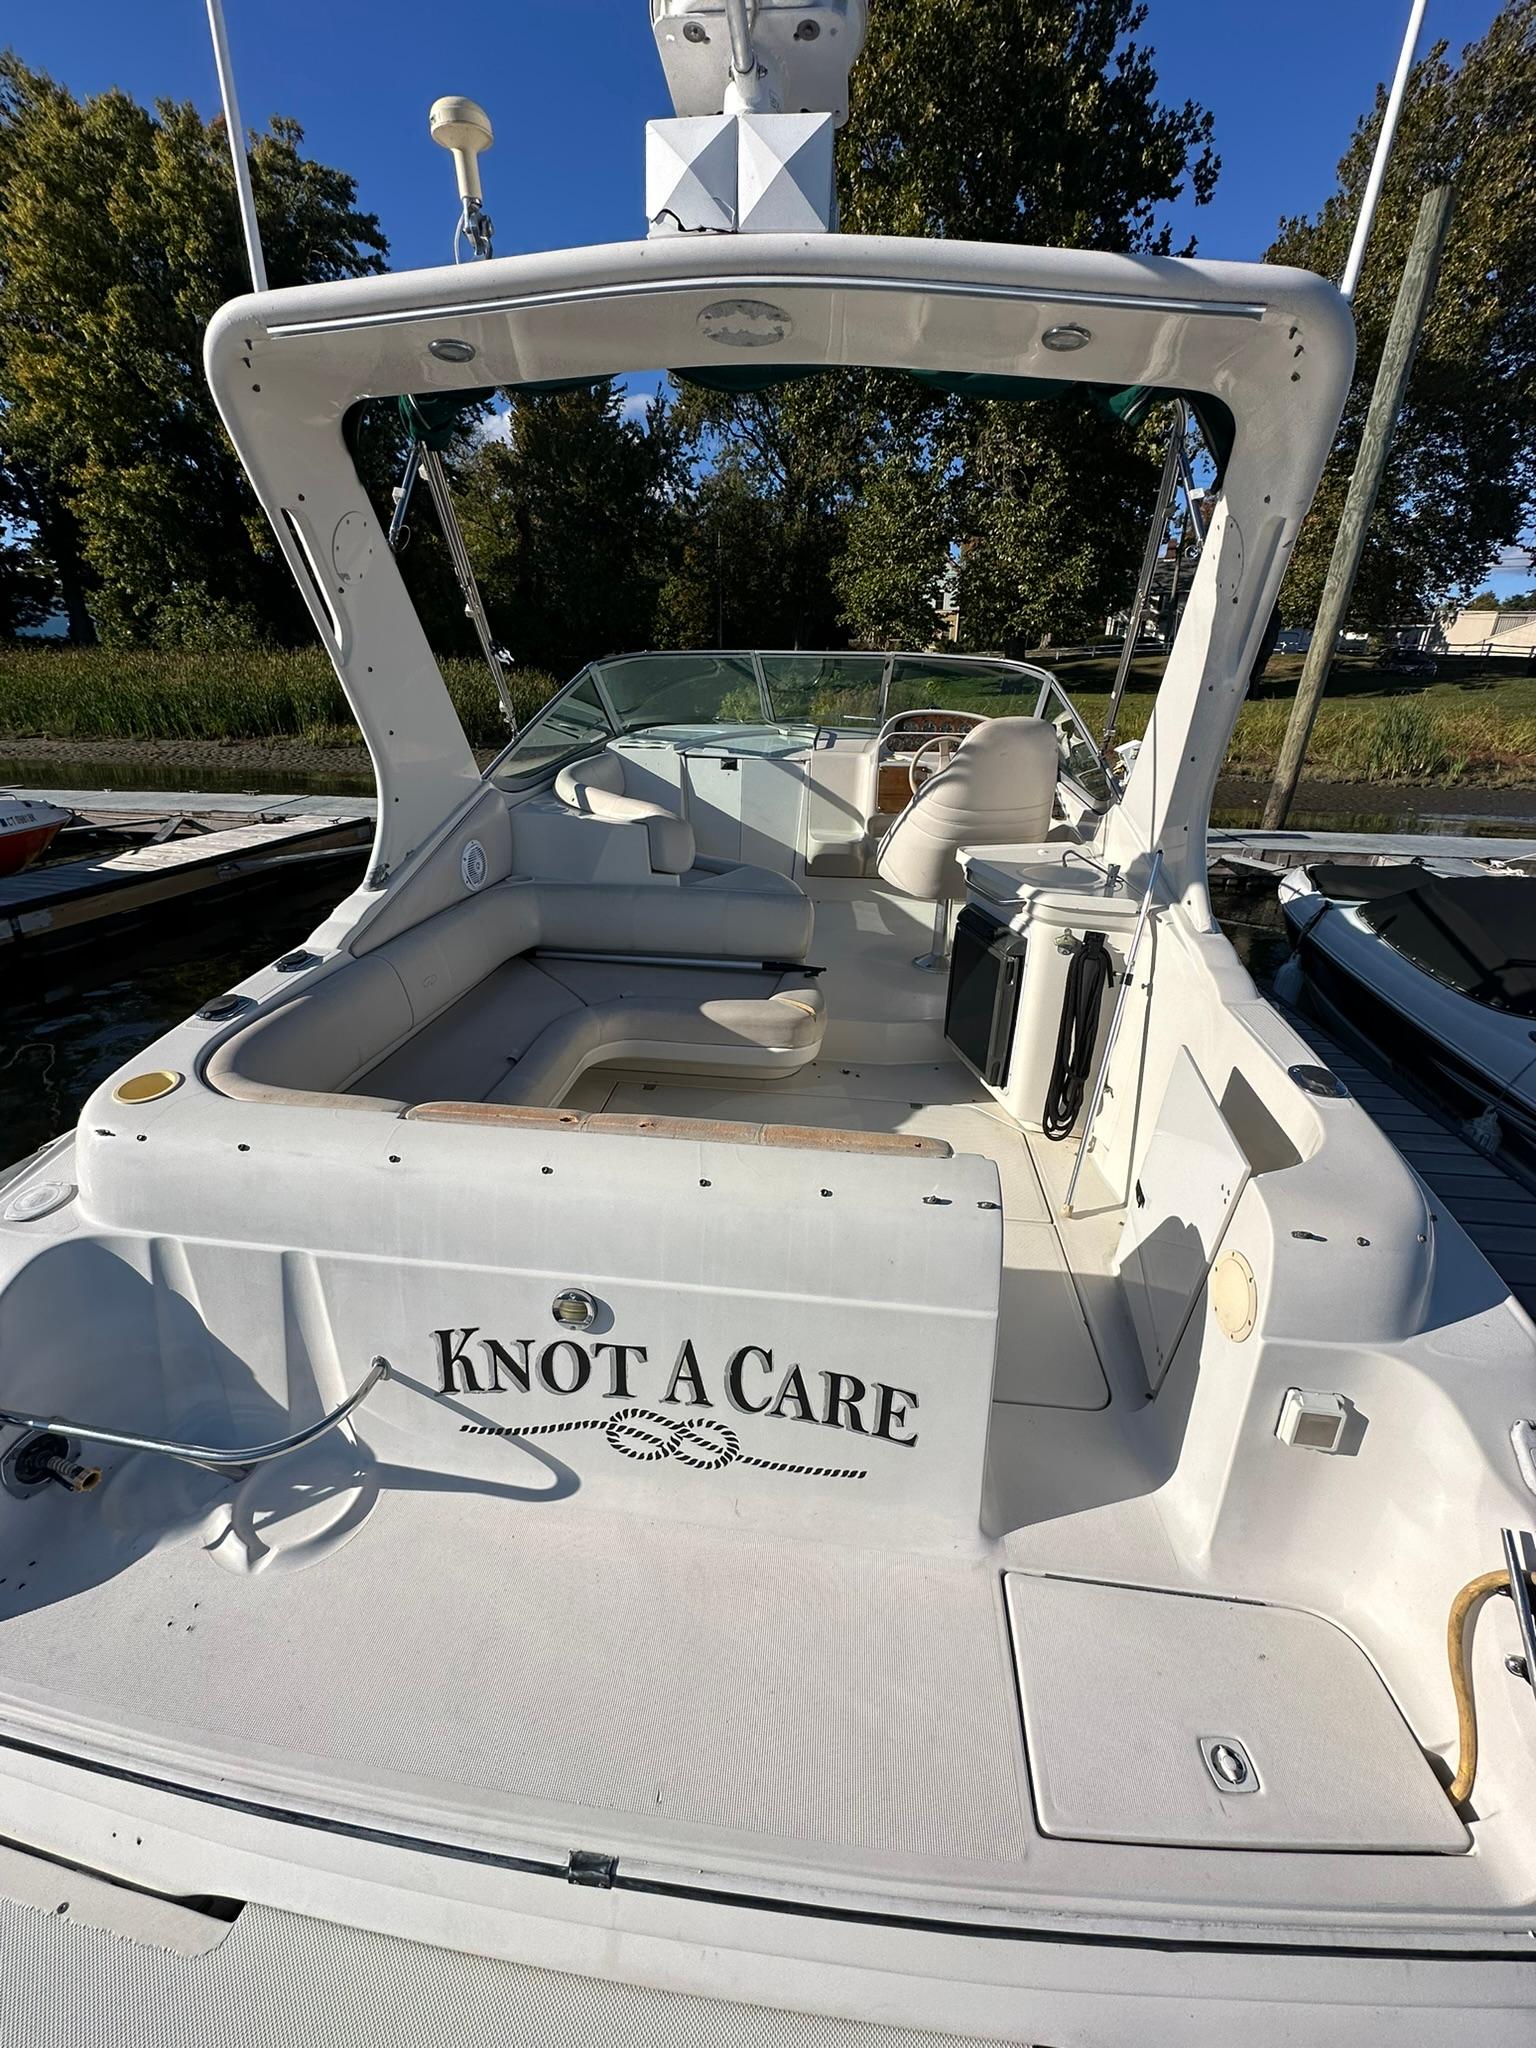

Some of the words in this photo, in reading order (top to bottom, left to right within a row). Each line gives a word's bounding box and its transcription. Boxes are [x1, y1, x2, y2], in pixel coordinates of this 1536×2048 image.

[429, 1327, 648, 1399] KNOT
[659, 1339, 714, 1408] A
[724, 1345, 921, 1448] CARE
